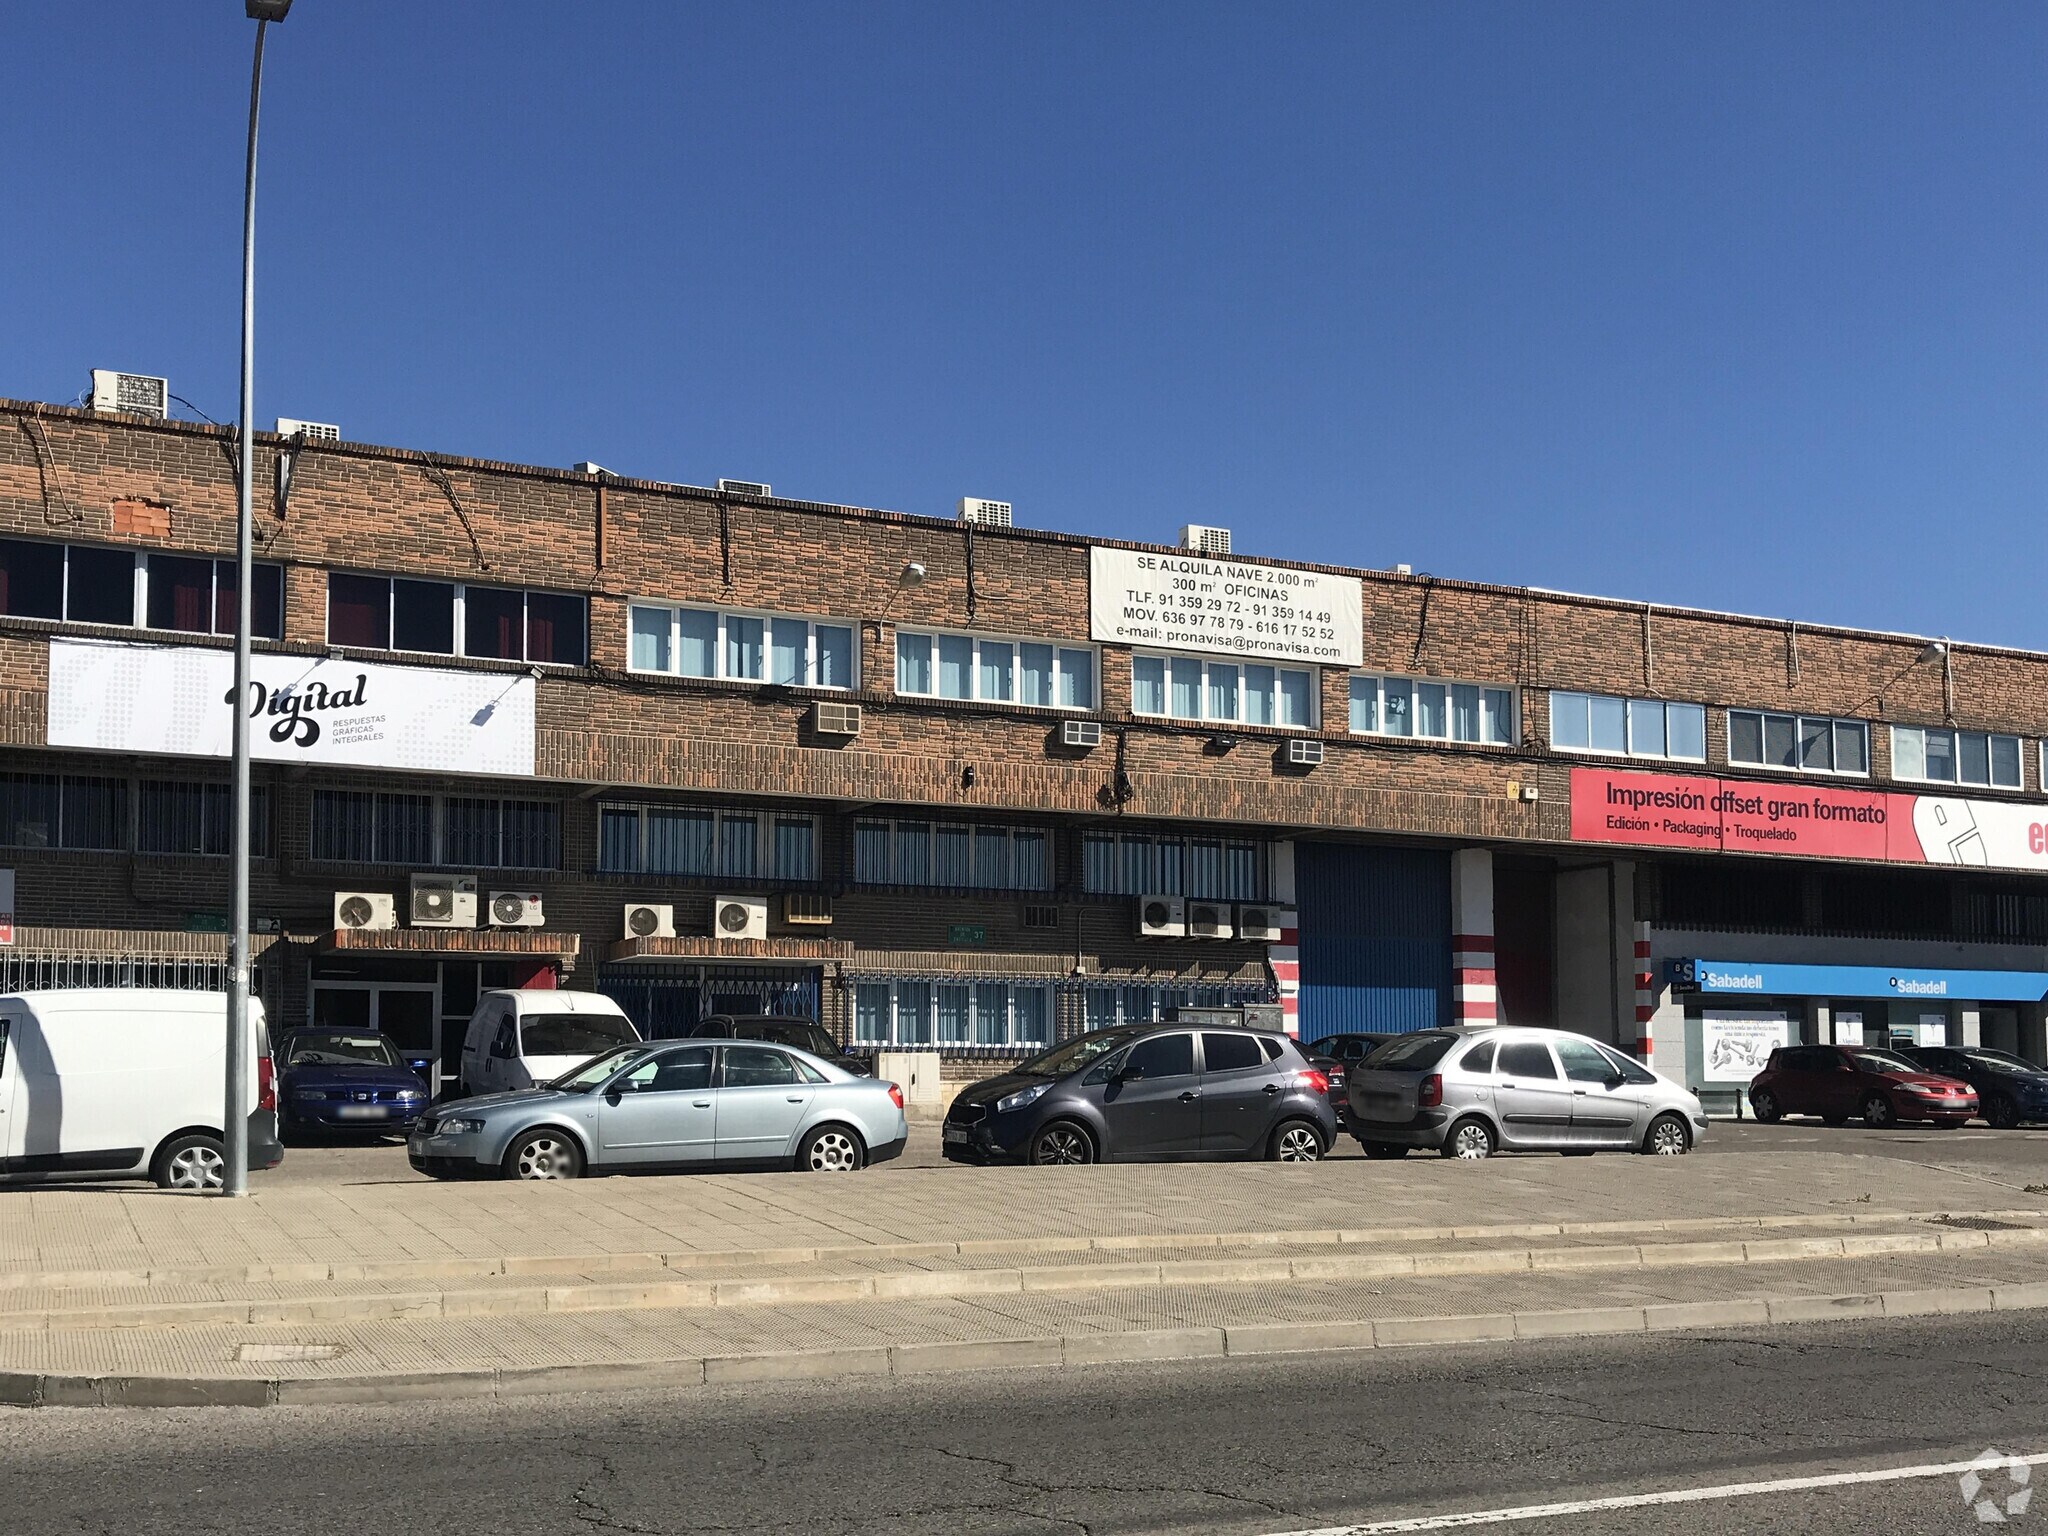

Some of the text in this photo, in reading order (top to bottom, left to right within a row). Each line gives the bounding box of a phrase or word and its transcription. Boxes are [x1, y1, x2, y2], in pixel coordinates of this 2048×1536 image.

[1137, 557, 1156, 570] SE
[1160, 559, 1223, 577] ALQUILA
[1226, 566, 1263, 581] NAVE
[1266, 571, 1300, 586] 2.000
[1172, 578, 1196, 591] 300
[1224, 583, 1289, 601] OFICINAS
[1126, 590, 1154, 604] TLF.
[1159, 594, 1174, 606] 91
[1179, 596, 1203, 609] 359
[1206, 599, 1222, 611] 29
[1226, 601, 1241, 613] 72
[1253, 603, 1267, 617] 91
[1271, 606, 1294, 619] 359
[1298, 609, 1313, 622] 14
[1316, 612, 1331, 624] 49
[1123, 607, 1158, 622] MOV.
[1162, 611, 1186, 625] 636
[1190, 614, 1206, 626] 97
[1209, 616, 1225, 629] 78
[1229, 618, 1244, 631] 79
[1256, 621, 1279, 634] 616
[1282, 624, 1297, 636] 17
[1301, 626, 1316, 638] 52
[1320, 628, 1334, 640] 52
[1116, 626, 1341, 657] e-mail: pronavisa@pronavisa.com
[332, 714, 386, 728] RESPUESTAS
[332, 724, 374, 737] GRÁFICAS
[332, 732, 384, 745] INTEGRALES
[1606, 781, 1886, 824] Impresión offset gran formato
[1606, 815, 1797, 841] Edición Packaging Troquelado
[974, 931, 984, 939] 37
[1708, 973, 1763, 989] Sabadell
[1897, 979, 1947, 995] Sabadell
